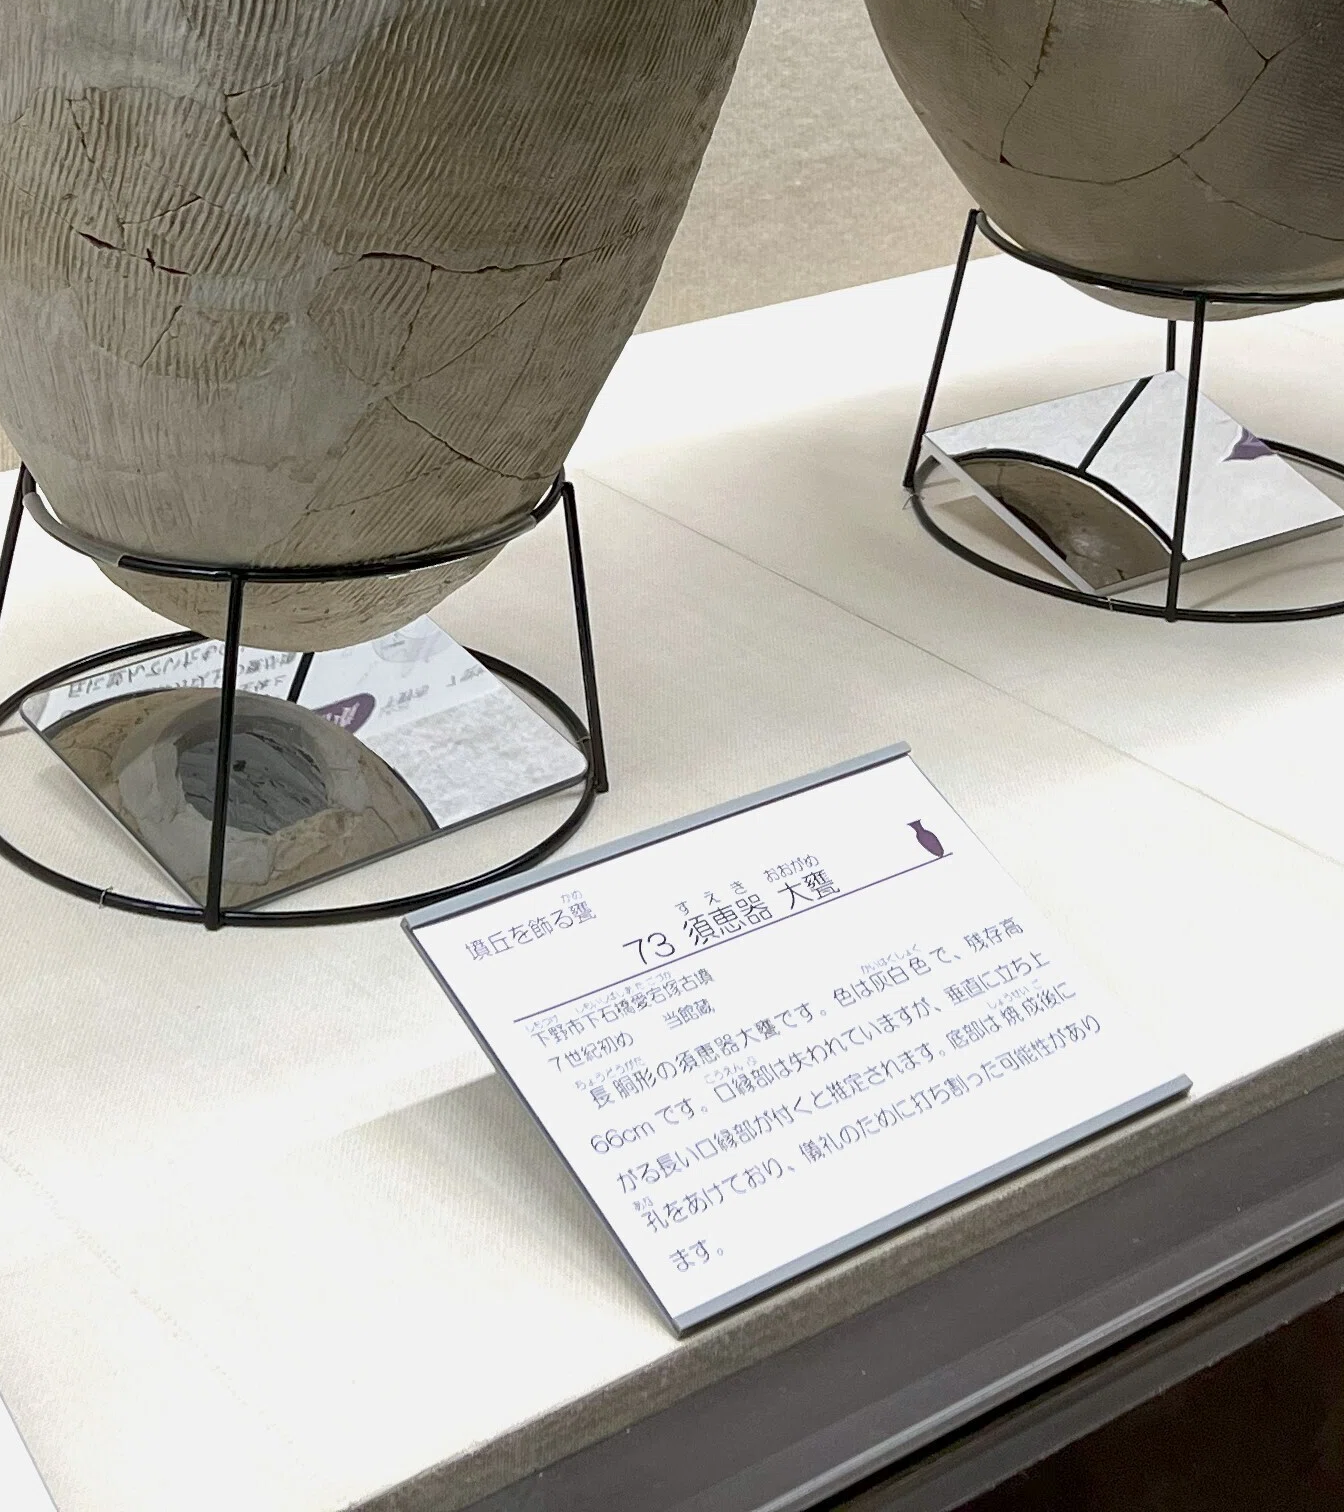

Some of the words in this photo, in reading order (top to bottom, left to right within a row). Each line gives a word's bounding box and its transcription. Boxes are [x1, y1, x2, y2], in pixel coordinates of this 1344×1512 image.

[763, 854, 821, 882] おおがめ
[464, 901, 597, 962] 墳丘を飾る甕
[622, 931, 677, 965] 73
[682, 893, 774, 948] 須恵器
[776, 868, 843, 912] 大甕
[530, 968, 714, 1047] 下野市下石橋愛宕塚古墳
[547, 1030, 635, 1073] 7世紀初め
[662, 997, 716, 1031] 当館蔵
[589, 1121, 655, 1155] 66cm
[669, 1238, 724, 1273] ます。
